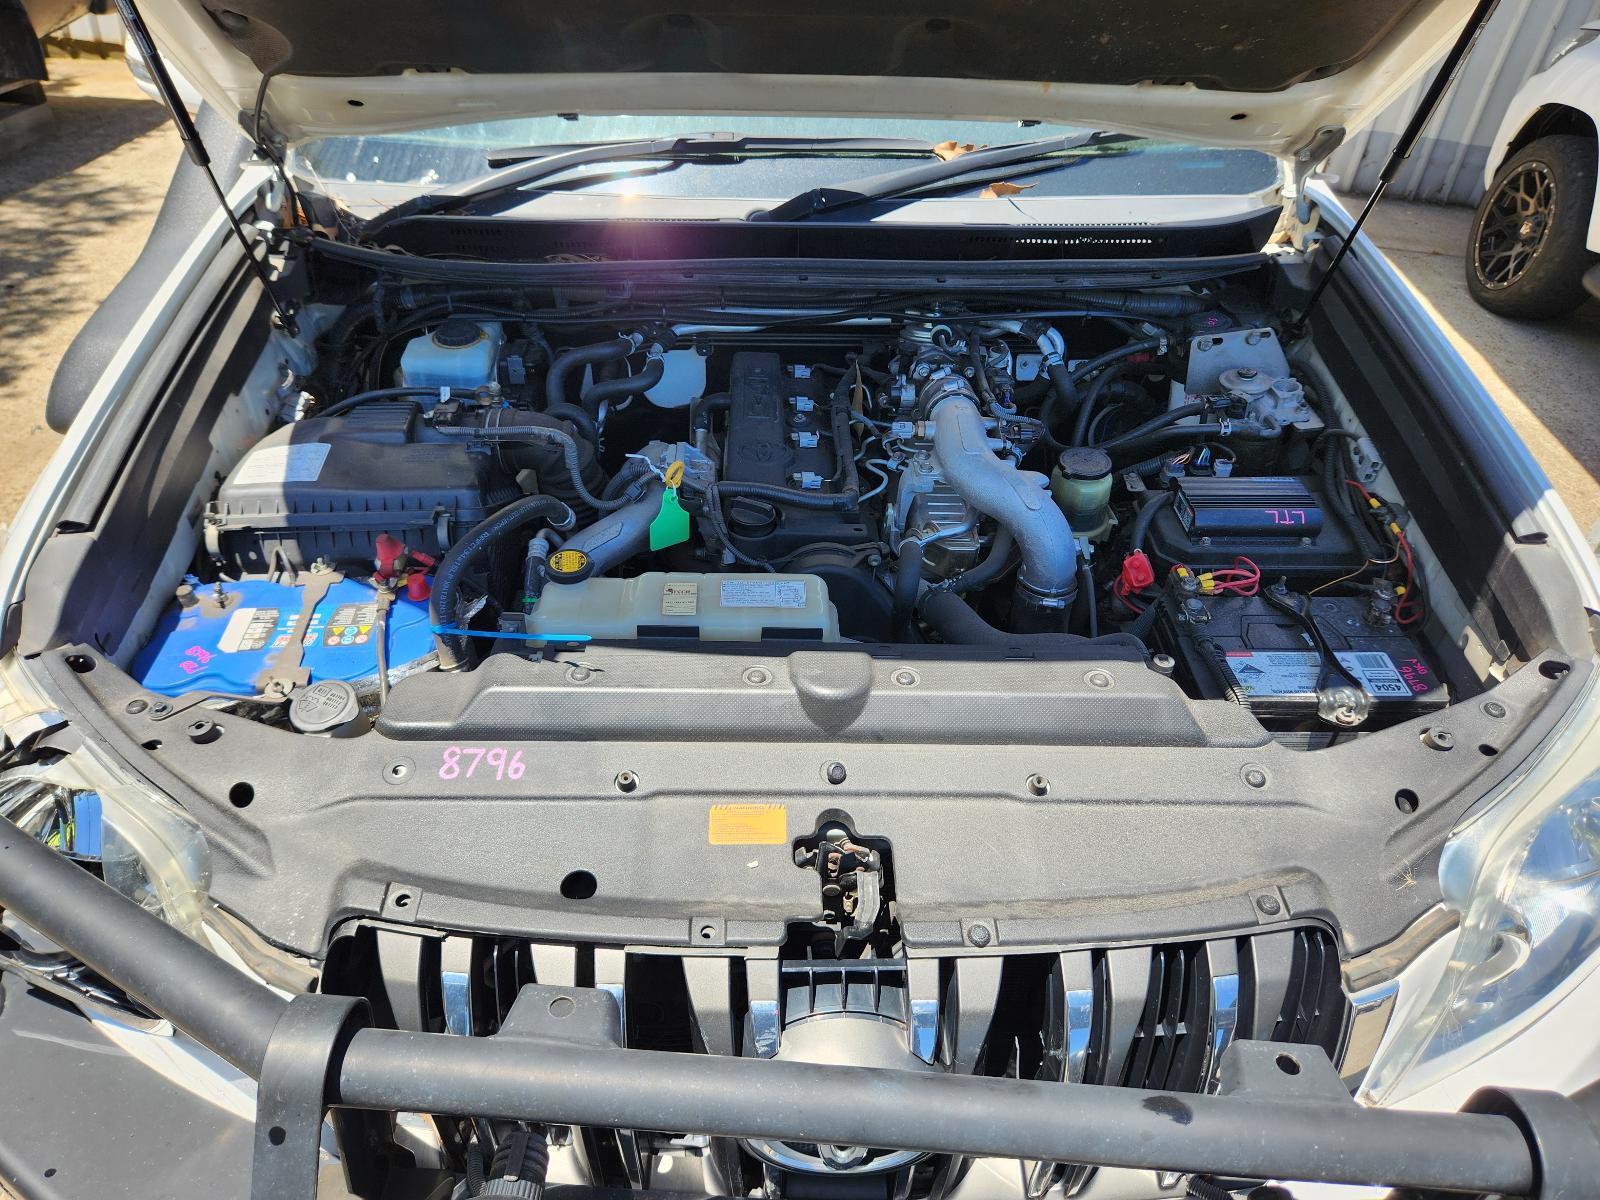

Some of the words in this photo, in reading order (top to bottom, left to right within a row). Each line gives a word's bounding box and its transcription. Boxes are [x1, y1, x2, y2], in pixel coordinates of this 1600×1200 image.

[1375, 683, 1402, 692] 4504
[1399, 665, 1429, 692] 8796
[438, 745, 527, 781] 8796
